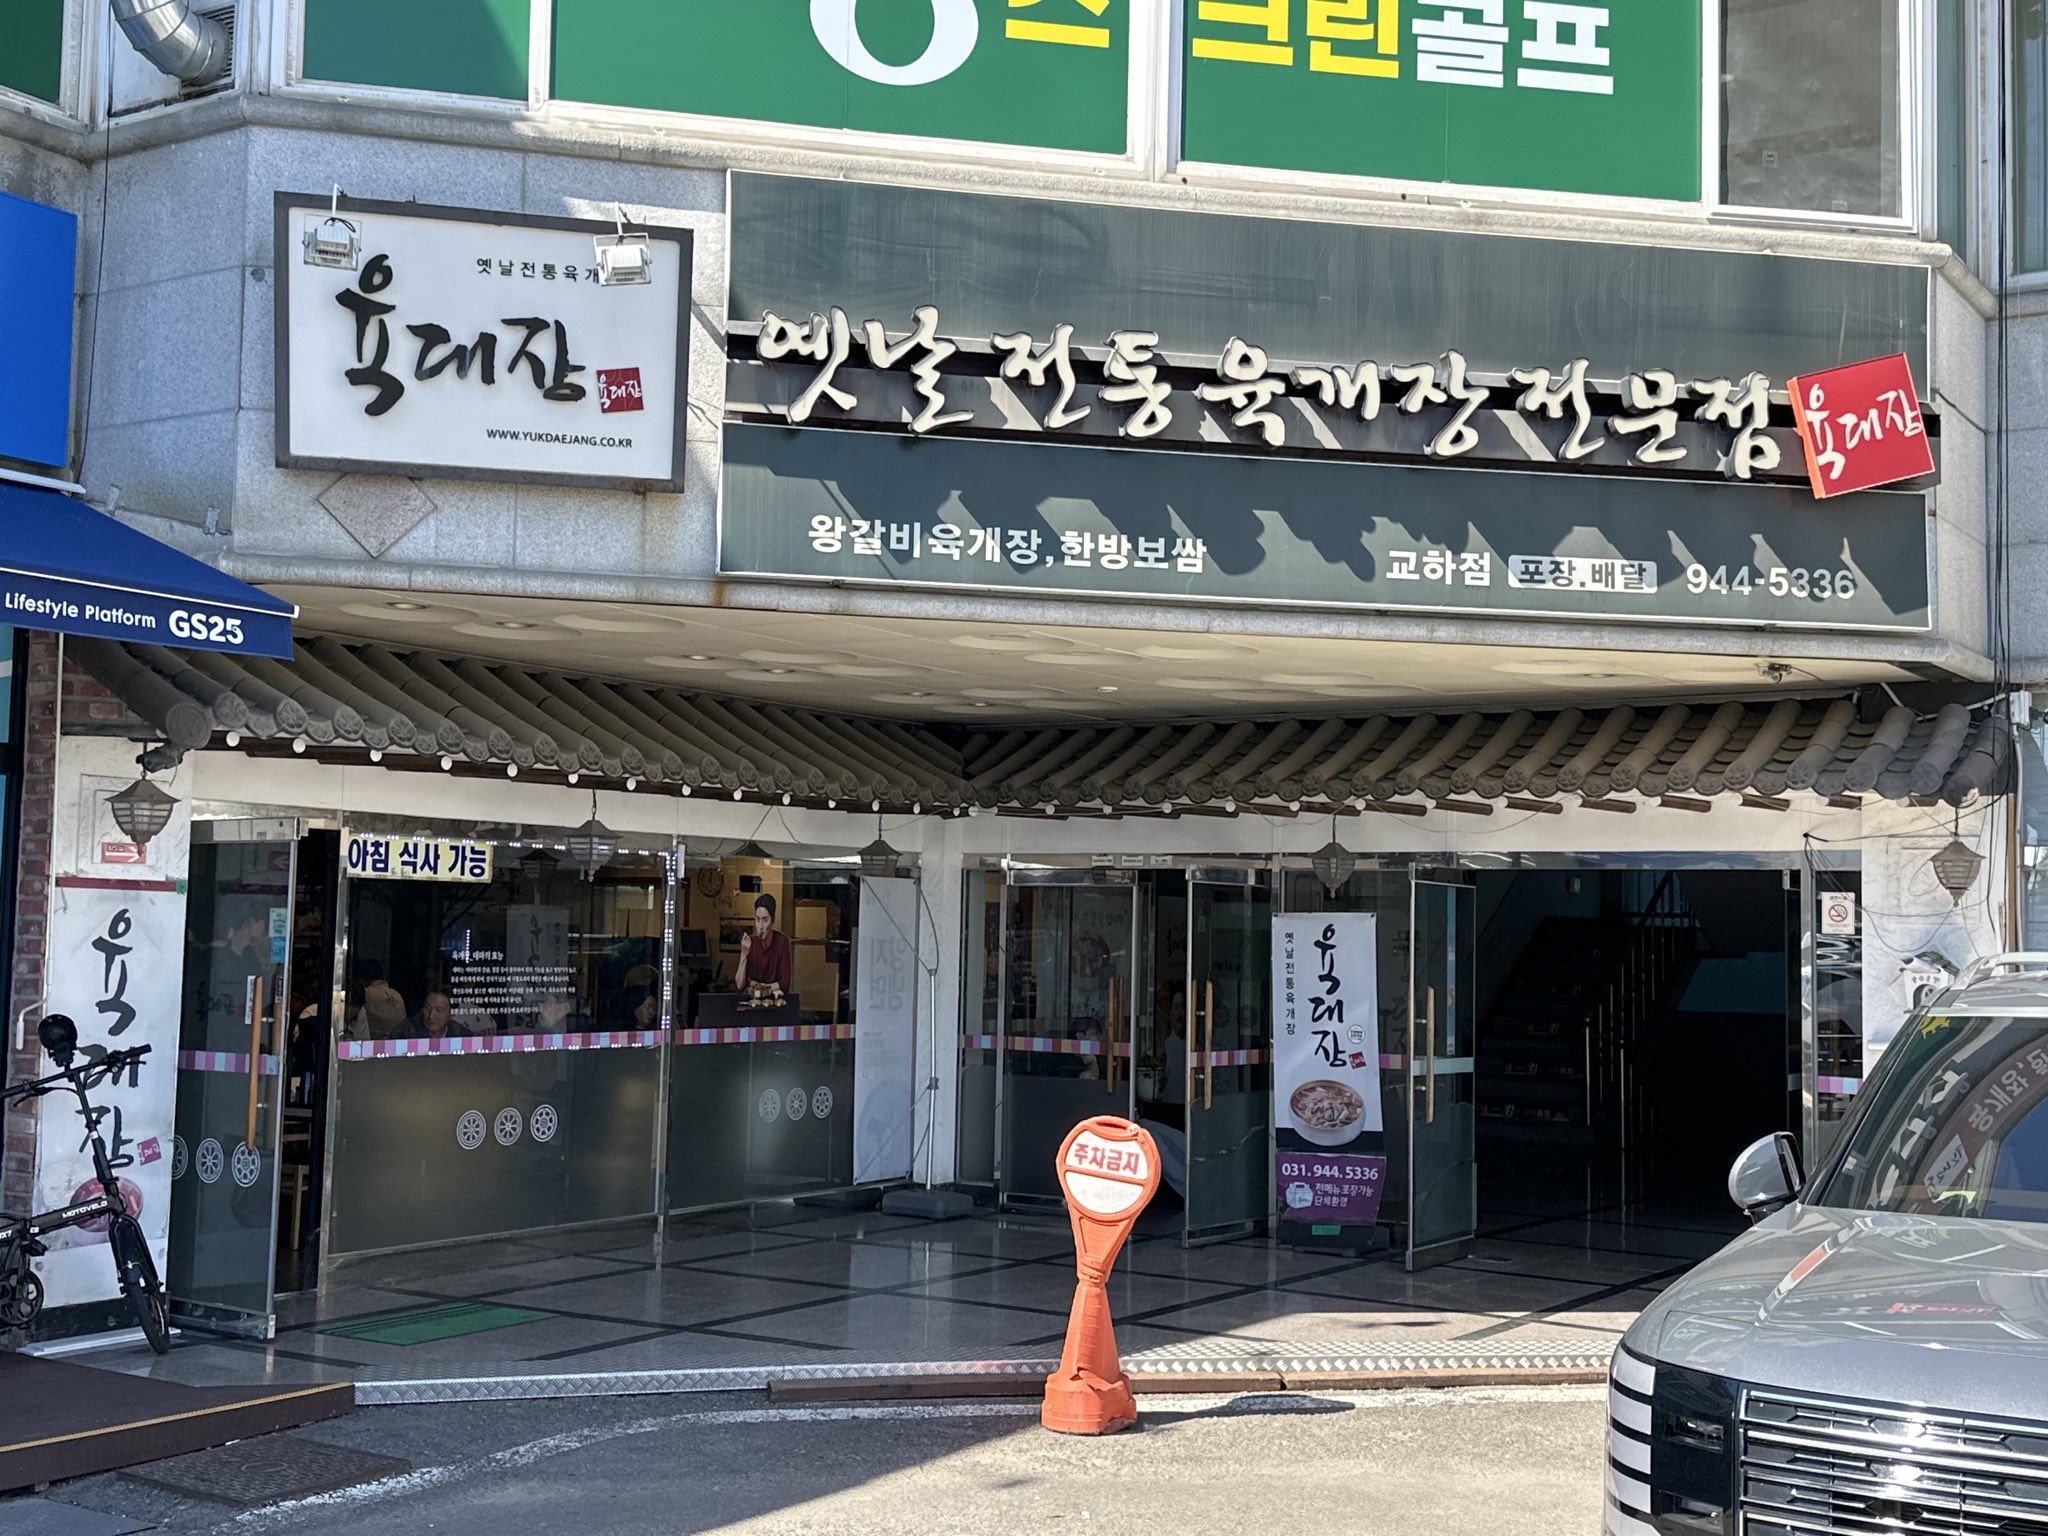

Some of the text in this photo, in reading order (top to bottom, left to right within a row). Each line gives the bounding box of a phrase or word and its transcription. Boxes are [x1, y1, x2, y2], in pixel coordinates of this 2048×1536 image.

[477, 257, 600, 284] 옛날전통육개
[335, 253, 588, 417] 육대장
[599, 373, 643, 410] 육대장
[486, 427, 633, 449] WWW.YUKDAEJANG.CO.KR
[1804, 383, 1922, 481] 육대장
[1386, 549, 1856, 601] 교하점 포장.배달 944-5336
[5, 592, 245, 646] Lifestyle Platform GS25
[348, 838, 486, 878] 아침 식사 가능
[1284, 931, 1296, 1036] 옛날전통육개장
[1308, 923, 1348, 1068] 육대장
[1074, 1142, 1140, 1175] 주차금지
[1281, 1163, 1379, 1181] 031.944.5336
[62, 1199, 108, 1219] MOTOVELO
